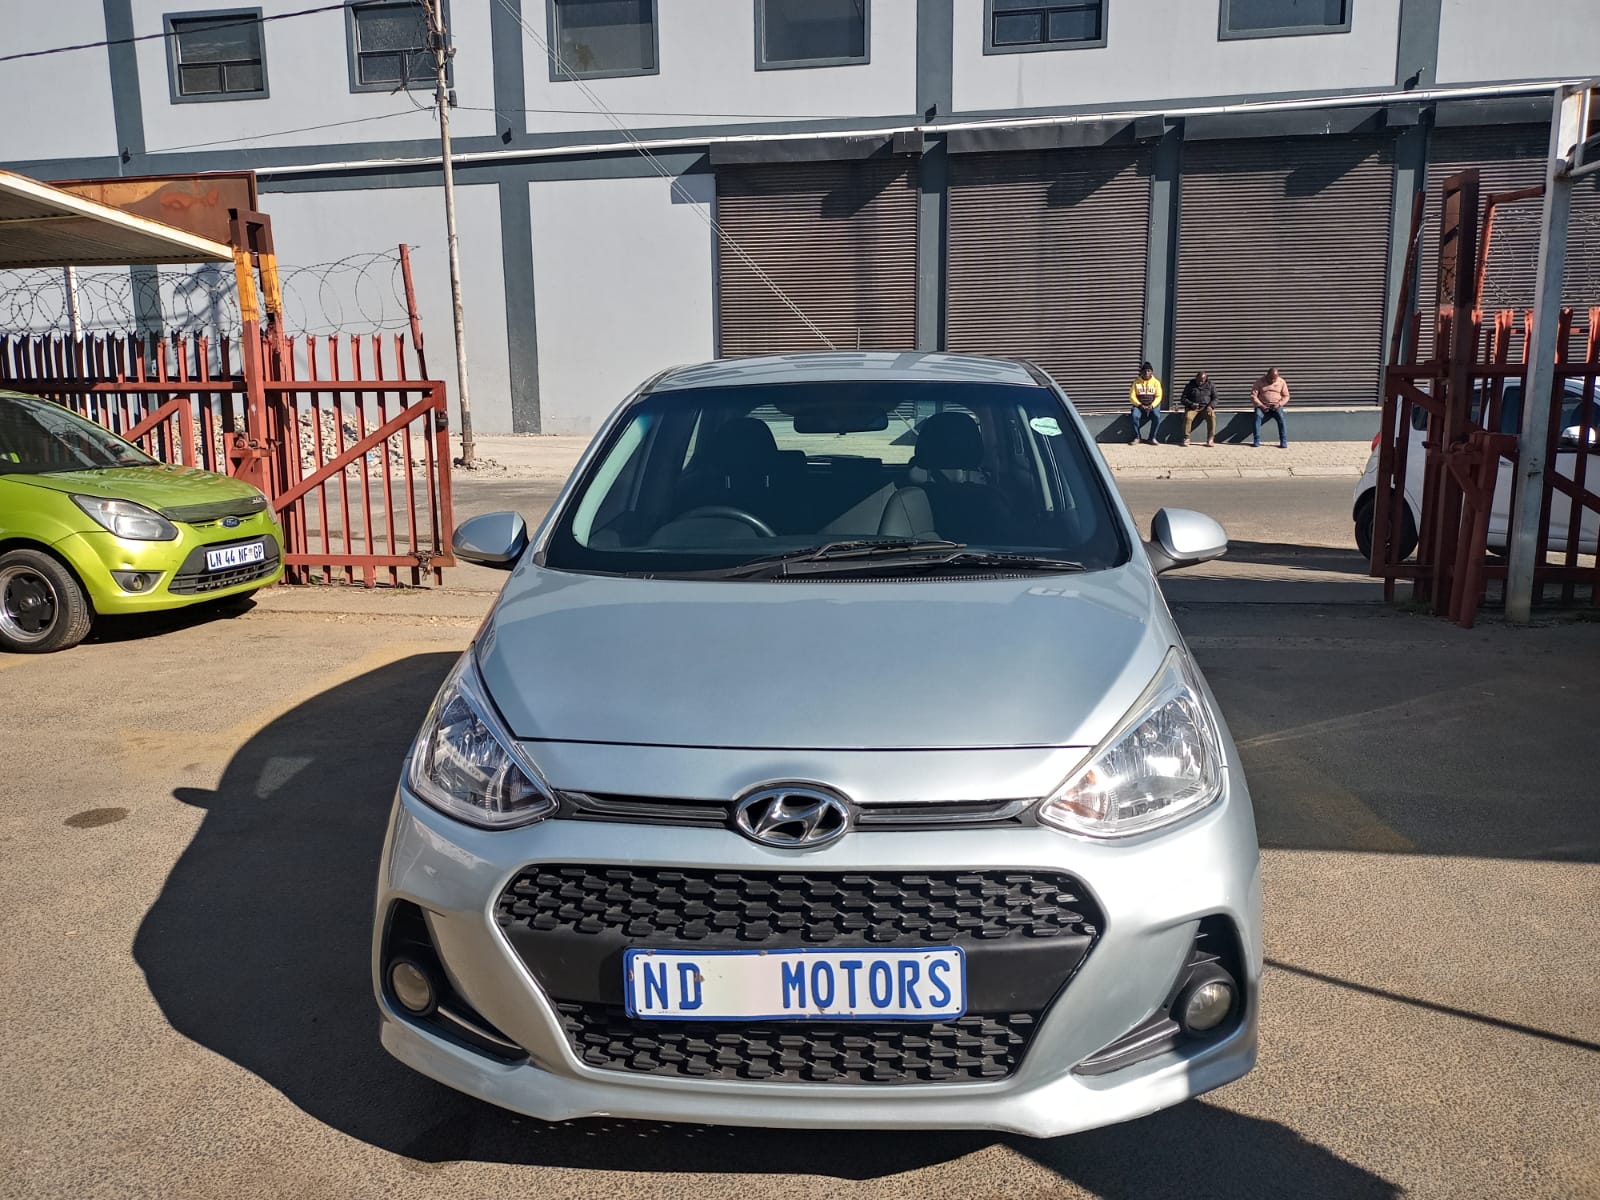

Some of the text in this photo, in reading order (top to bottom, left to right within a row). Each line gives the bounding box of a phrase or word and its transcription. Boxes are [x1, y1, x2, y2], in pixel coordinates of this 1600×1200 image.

[209, 544, 263, 568] LN 44 NF GP
[643, 958, 952, 1010] ND MOTORS
